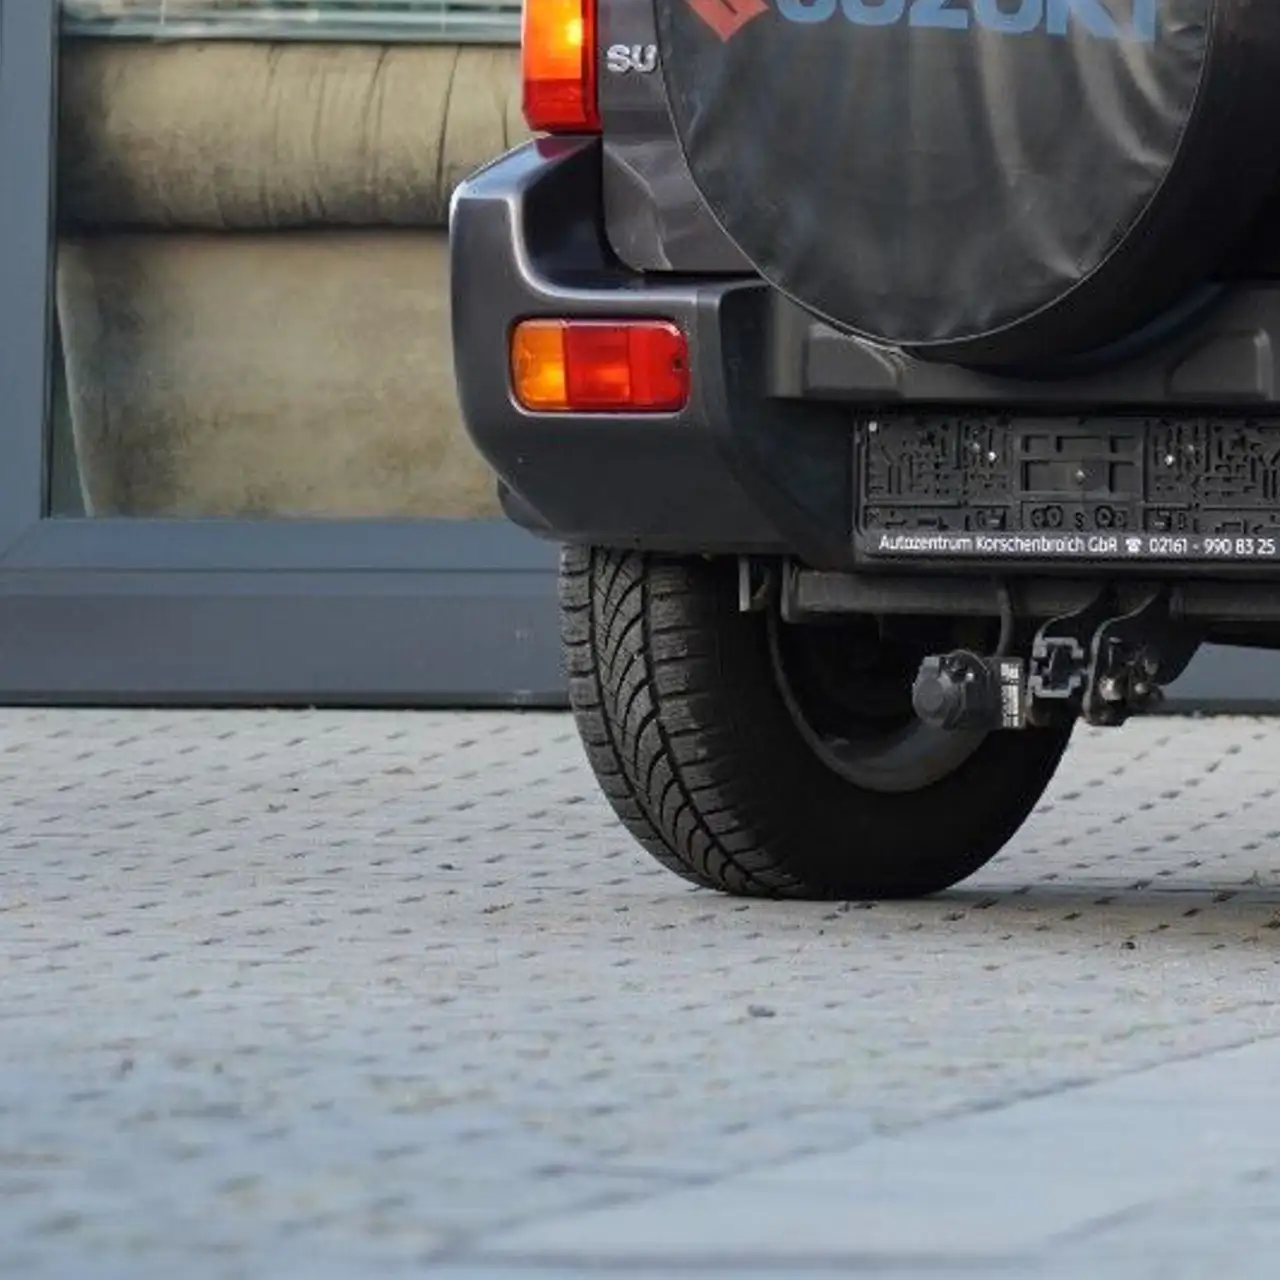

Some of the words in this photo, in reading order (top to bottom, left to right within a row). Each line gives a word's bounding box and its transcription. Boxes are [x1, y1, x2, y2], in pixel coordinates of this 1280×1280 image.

[878, 534, 973, 551] Autozentrum
[976, 535, 1084, 553] Korschenbroich
[1087, 536, 1118, 554] GbR
[1149, 537, 1188, 554] 02161
[1204, 538, 1233, 555] 990
[1235, 538, 1255, 556] 83
[1257, 538, 1276, 556] 25
